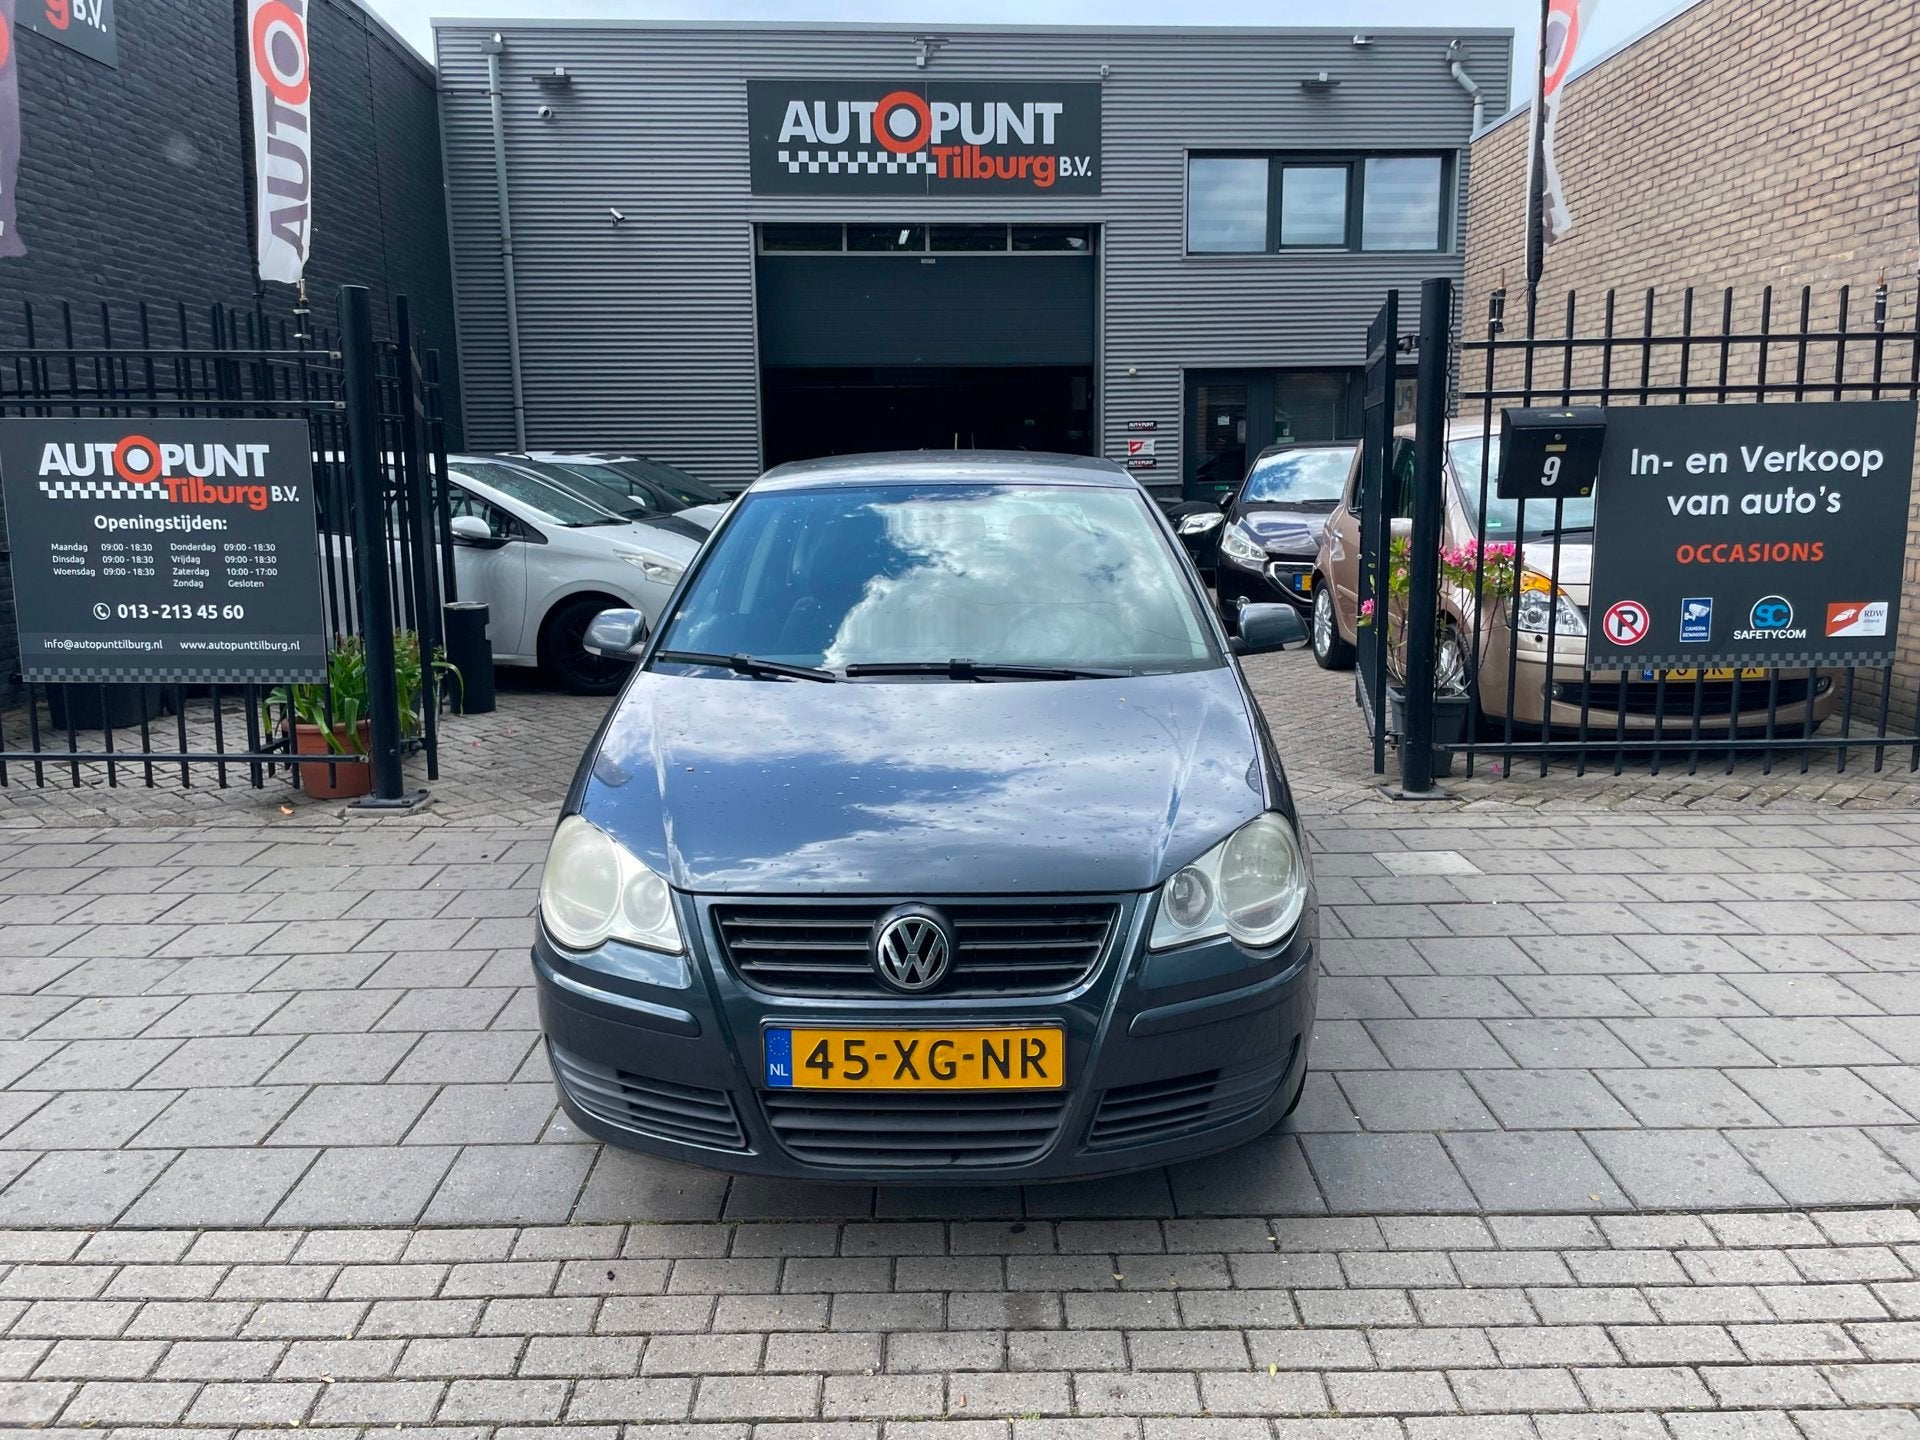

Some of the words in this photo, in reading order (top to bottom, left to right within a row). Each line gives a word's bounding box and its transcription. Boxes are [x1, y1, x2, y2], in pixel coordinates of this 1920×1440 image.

[778, 91, 1063, 154] AUTOPUNT
[253, 0, 311, 263] AUTO
[932, 145, 1056, 187] Tilburg
[1059, 156, 1092, 177] B.V.
[39, 435, 270, 484] AUTOPUNT
[1630, 448, 1673, 475] In-
[1685, 452, 1728, 474] en
[1740, 444, 1884, 478] Verkoop
[1540, 456, 1561, 487] 9
[163, 477, 268, 511] Tilburg
[271, 486, 300, 502] B.V.
[1667, 494, 1728, 516] van
[1740, 486, 1842, 515] auto's
[94, 514, 228, 532] Openingstijden:
[51, 543, 88, 553] Maandag
[101, 543, 124, 551] 09:00
[130, 543, 153, 551] 18:30
[170, 543, 216, 553] Donderdag
[224, 543, 247, 551] 09:00
[253, 543, 276, 551] 18:30
[1676, 542, 1825, 564] OCCASIONS
[52, 555, 85, 565] Dinsdag
[102, 555, 125, 563] 09:00
[131, 555, 154, 563] 18:30
[171, 555, 201, 565] Vrijdag
[225, 555, 248, 563] 09:00
[254, 555, 277, 563] 18:30
[53, 568, 96, 578] Woensdag
[103, 568, 126, 576] 09:00
[132, 568, 155, 576] 18:30
[172, 568, 210, 578] Zaterdag
[226, 568, 249, 576] 10:00
[255, 568, 278, 576] 17:00
[173, 579, 204, 589] Zondag
[228, 579, 265, 587] Gesloten
[196, 605, 218, 620] 45
[222, 604, 244, 620] 60
[1864, 609, 1885, 617] RDW
[1733, 629, 1807, 640] SAFETYCOM
[44, 639, 163, 651] info@autopunttilburg.nl
[180, 640, 300, 652] www.autopunttilburg.nl
[769, 1063, 789, 1077] NL
[805, 1038, 1047, 1080] 45-XG-NR
